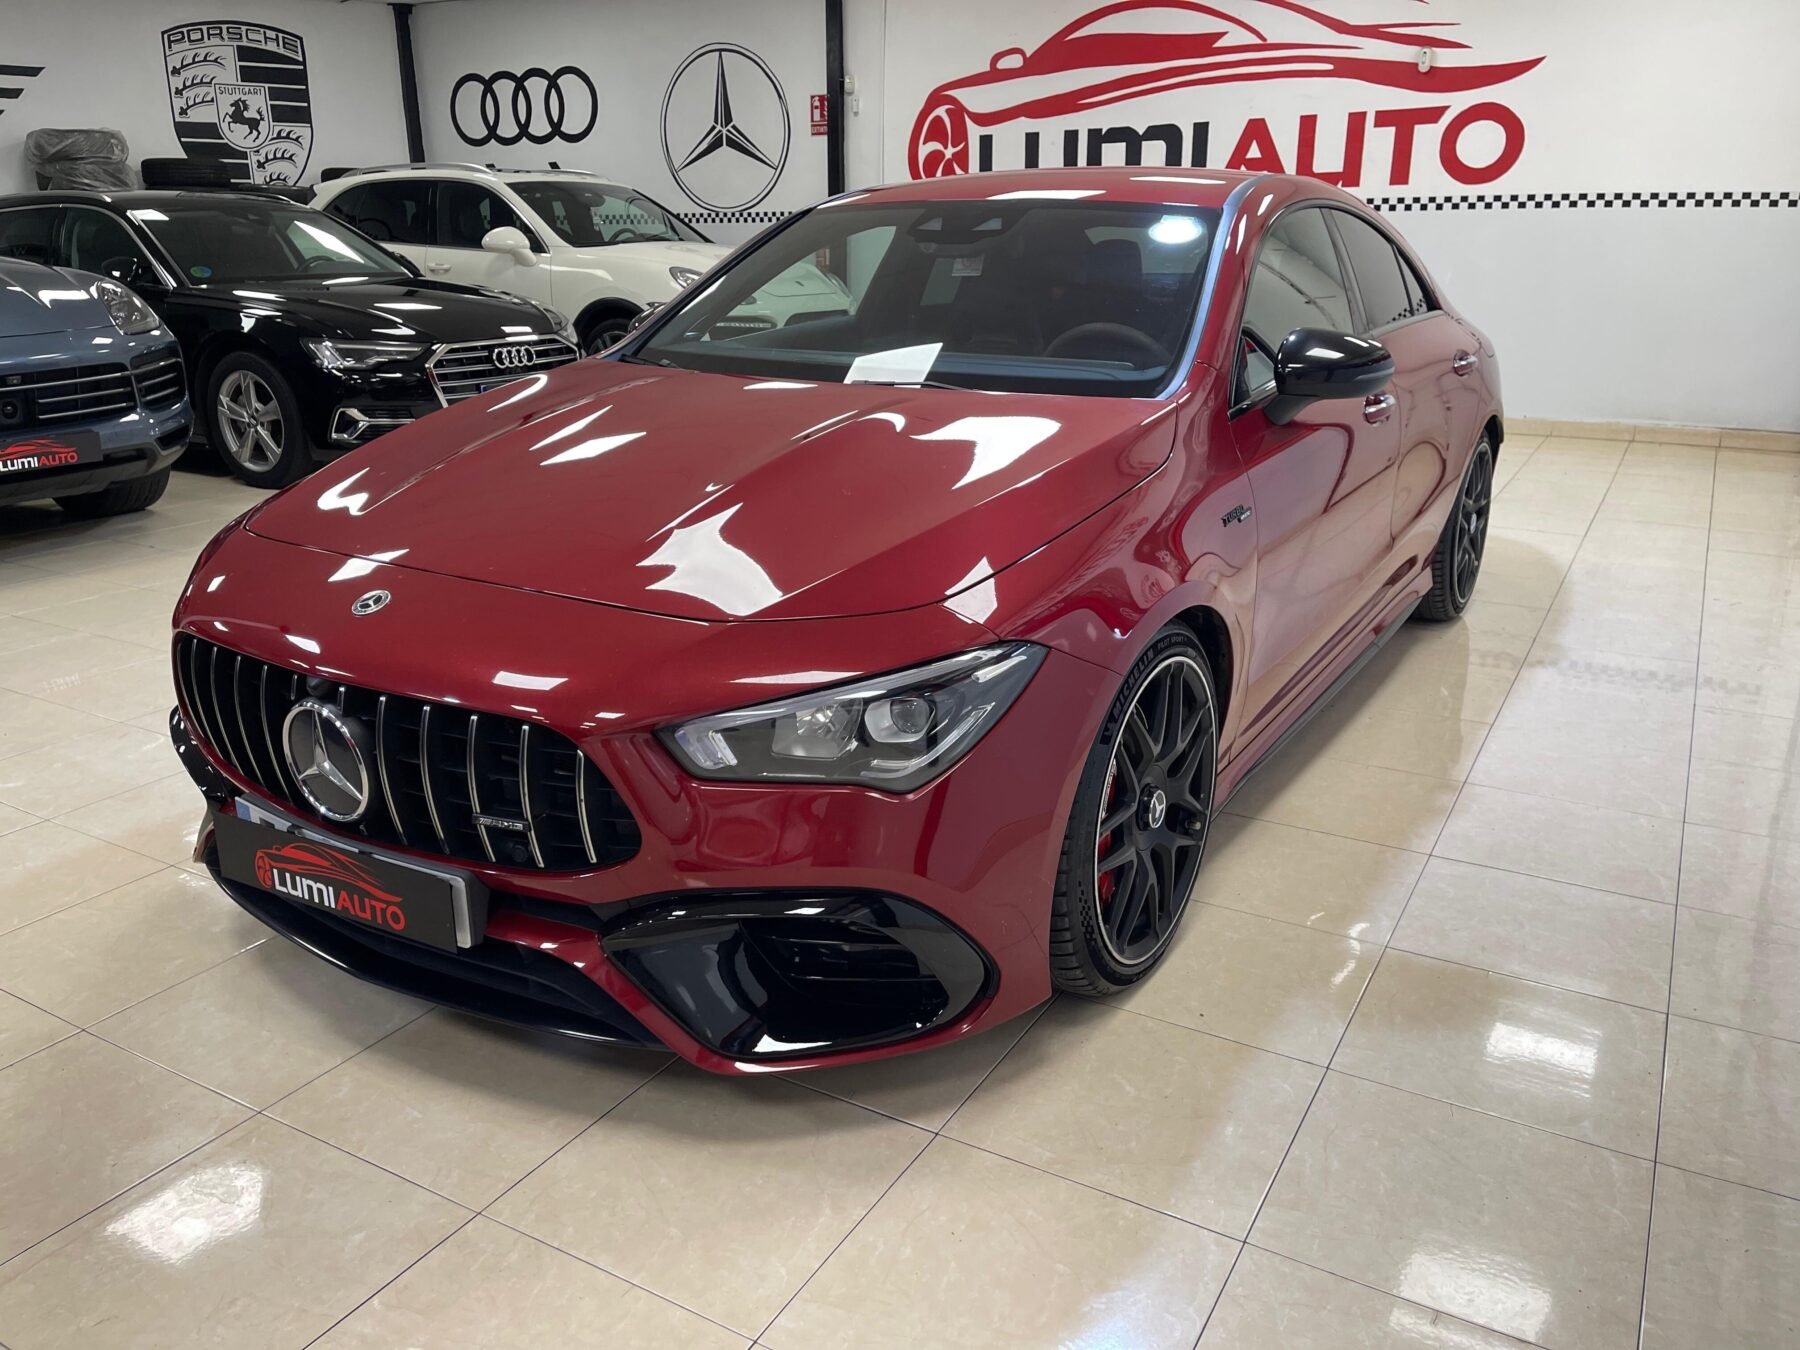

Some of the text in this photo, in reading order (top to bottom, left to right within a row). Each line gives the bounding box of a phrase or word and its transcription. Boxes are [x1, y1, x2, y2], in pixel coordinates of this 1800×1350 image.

[167, 26, 300, 55] PORSCHE
[218, 87, 263, 97] STUTTGART
[1112, 648, 1155, 719] MICHELIN
[272, 868, 406, 930] LUMIAUTO
